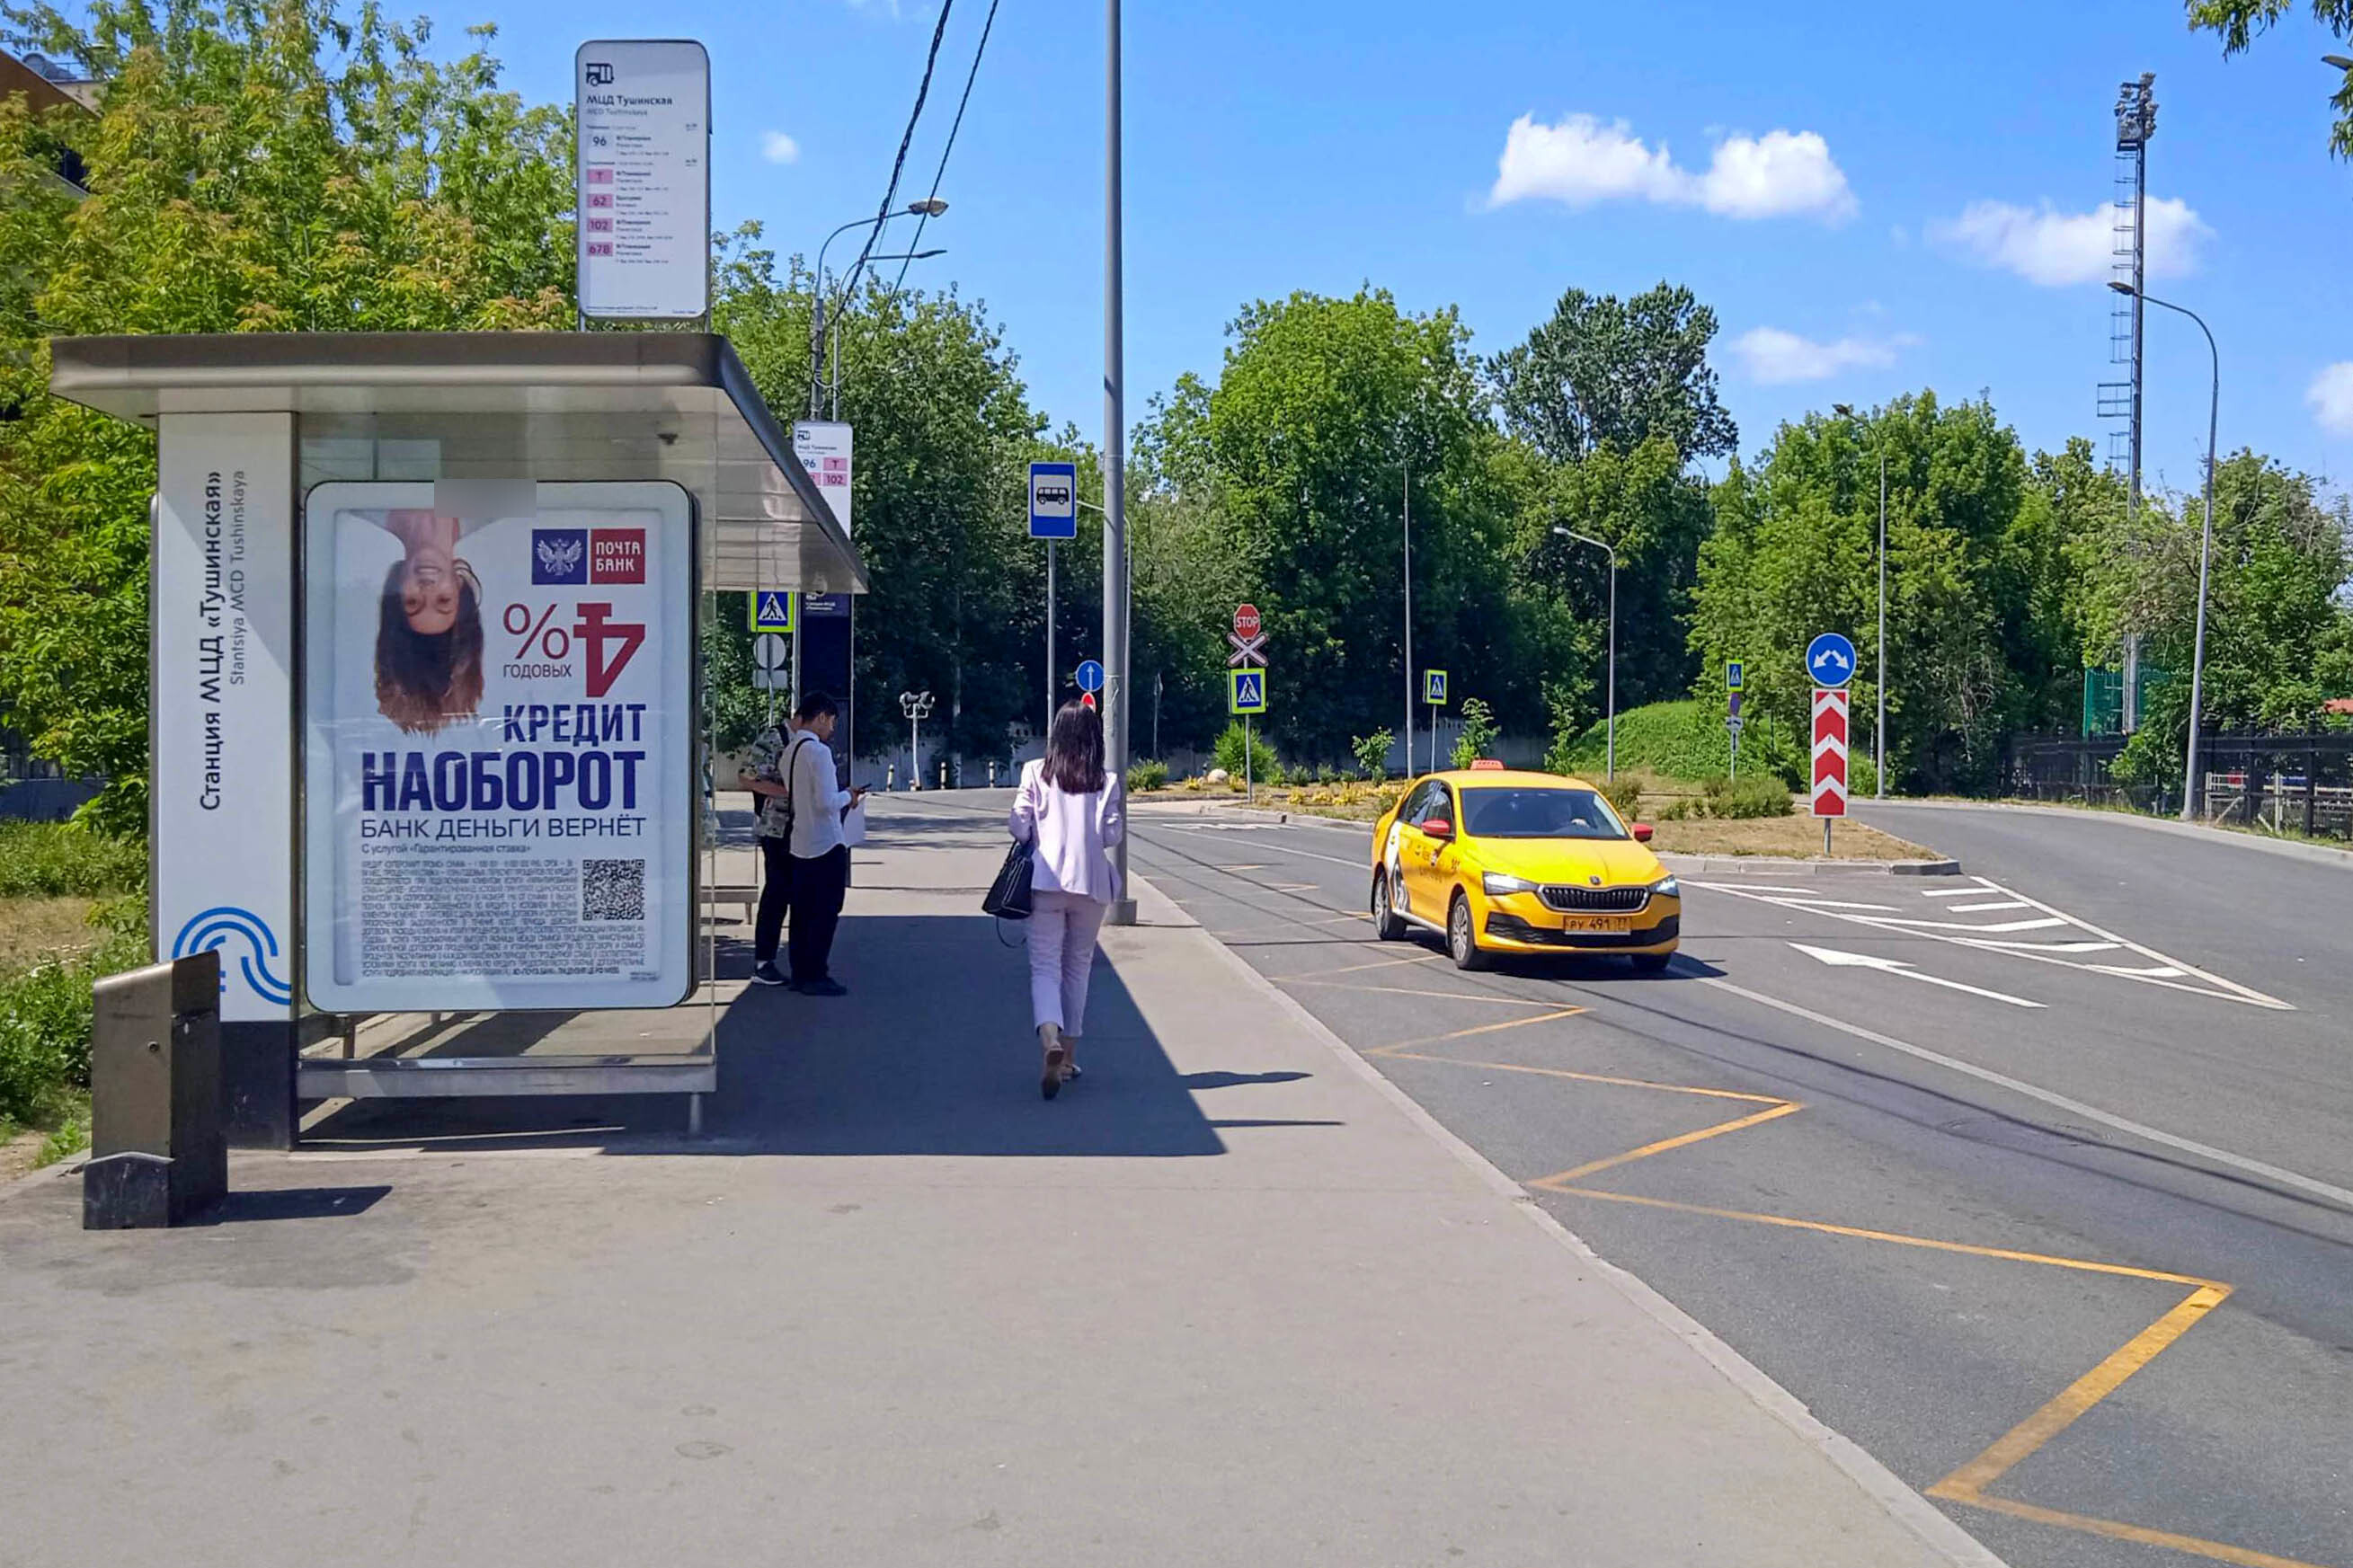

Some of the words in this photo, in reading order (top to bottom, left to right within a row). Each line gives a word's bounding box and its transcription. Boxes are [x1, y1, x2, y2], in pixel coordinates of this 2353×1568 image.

[586, 95, 615, 106] МЦД
[617, 95, 673, 107] Тушинская
[592, 136, 608, 146] 96
[593, 196, 607, 207] 62
[590, 219, 608, 231] 102
[803, 459, 816, 468] 96
[827, 474, 843, 484] 102
[230, 470, 248, 563] Tushinskaya
[200, 471, 226, 628] «Тушинская»
[596, 541, 641, 555] ПОЧТА
[596, 558, 635, 572] БАНК
[230, 569, 244, 612] MCD
[1237, 616, 1258, 628] STOP
[230, 617, 247, 685] Stantsiya
[200, 635, 224, 703] МЦД
[503, 663, 573, 680] ГОДОВЫХ
[504, 704, 647, 747] КРЕДИТ
[200, 713, 224, 810] Станция
[362, 751, 646, 811] НАОБОРОТ
[361, 819, 431, 838] БАНК
[436, 819, 539, 842] ДЕНЬГИ
[548, 813, 647, 837] ВЕРНЁТ
[361, 843, 369, 854] С
[371, 843, 408, 855] услугой
[1589, 917, 1610, 930] 491
